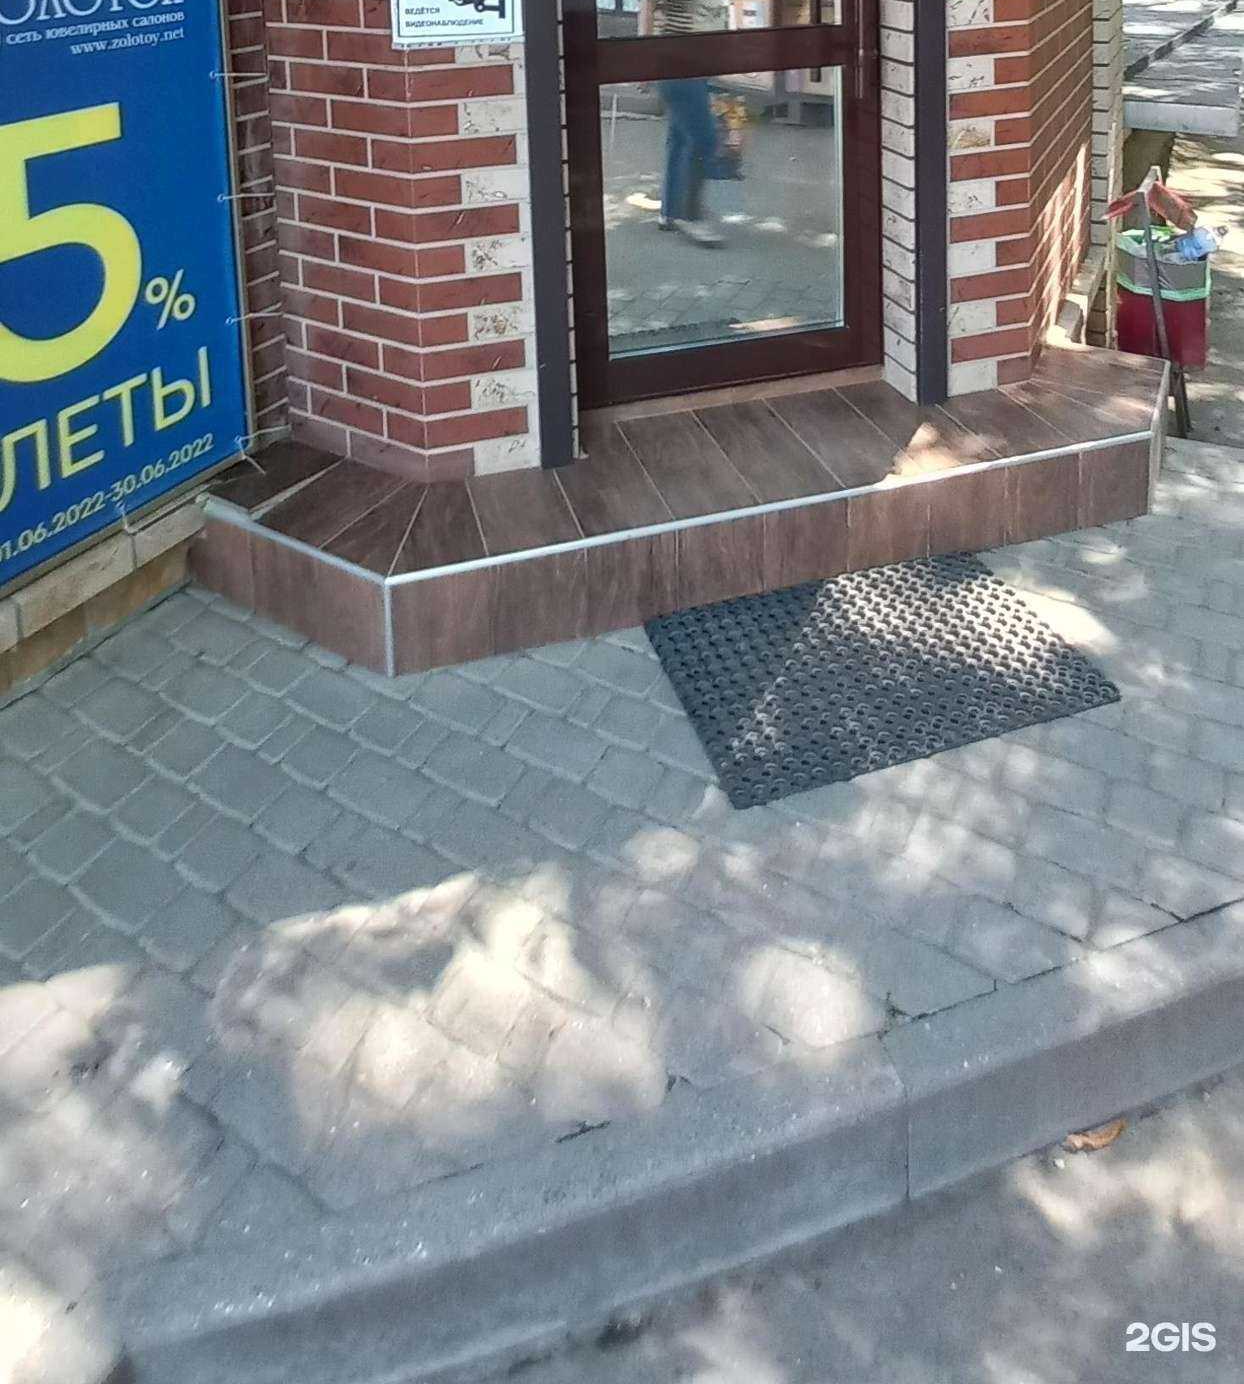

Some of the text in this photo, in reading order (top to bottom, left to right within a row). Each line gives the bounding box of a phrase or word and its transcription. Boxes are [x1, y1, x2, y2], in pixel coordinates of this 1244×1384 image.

[6, 10, 184, 45] сеть ювелирных салонов
[405, 18, 484, 28] ВИДЕОНАБЛЮДЕНИЕ
[70, 27, 184, 55] www.zolotoy.net
[0, 346, 212, 514] ЛЕТЫ
[0, 432, 214, 563] 1.06.2022-30.06.2022
